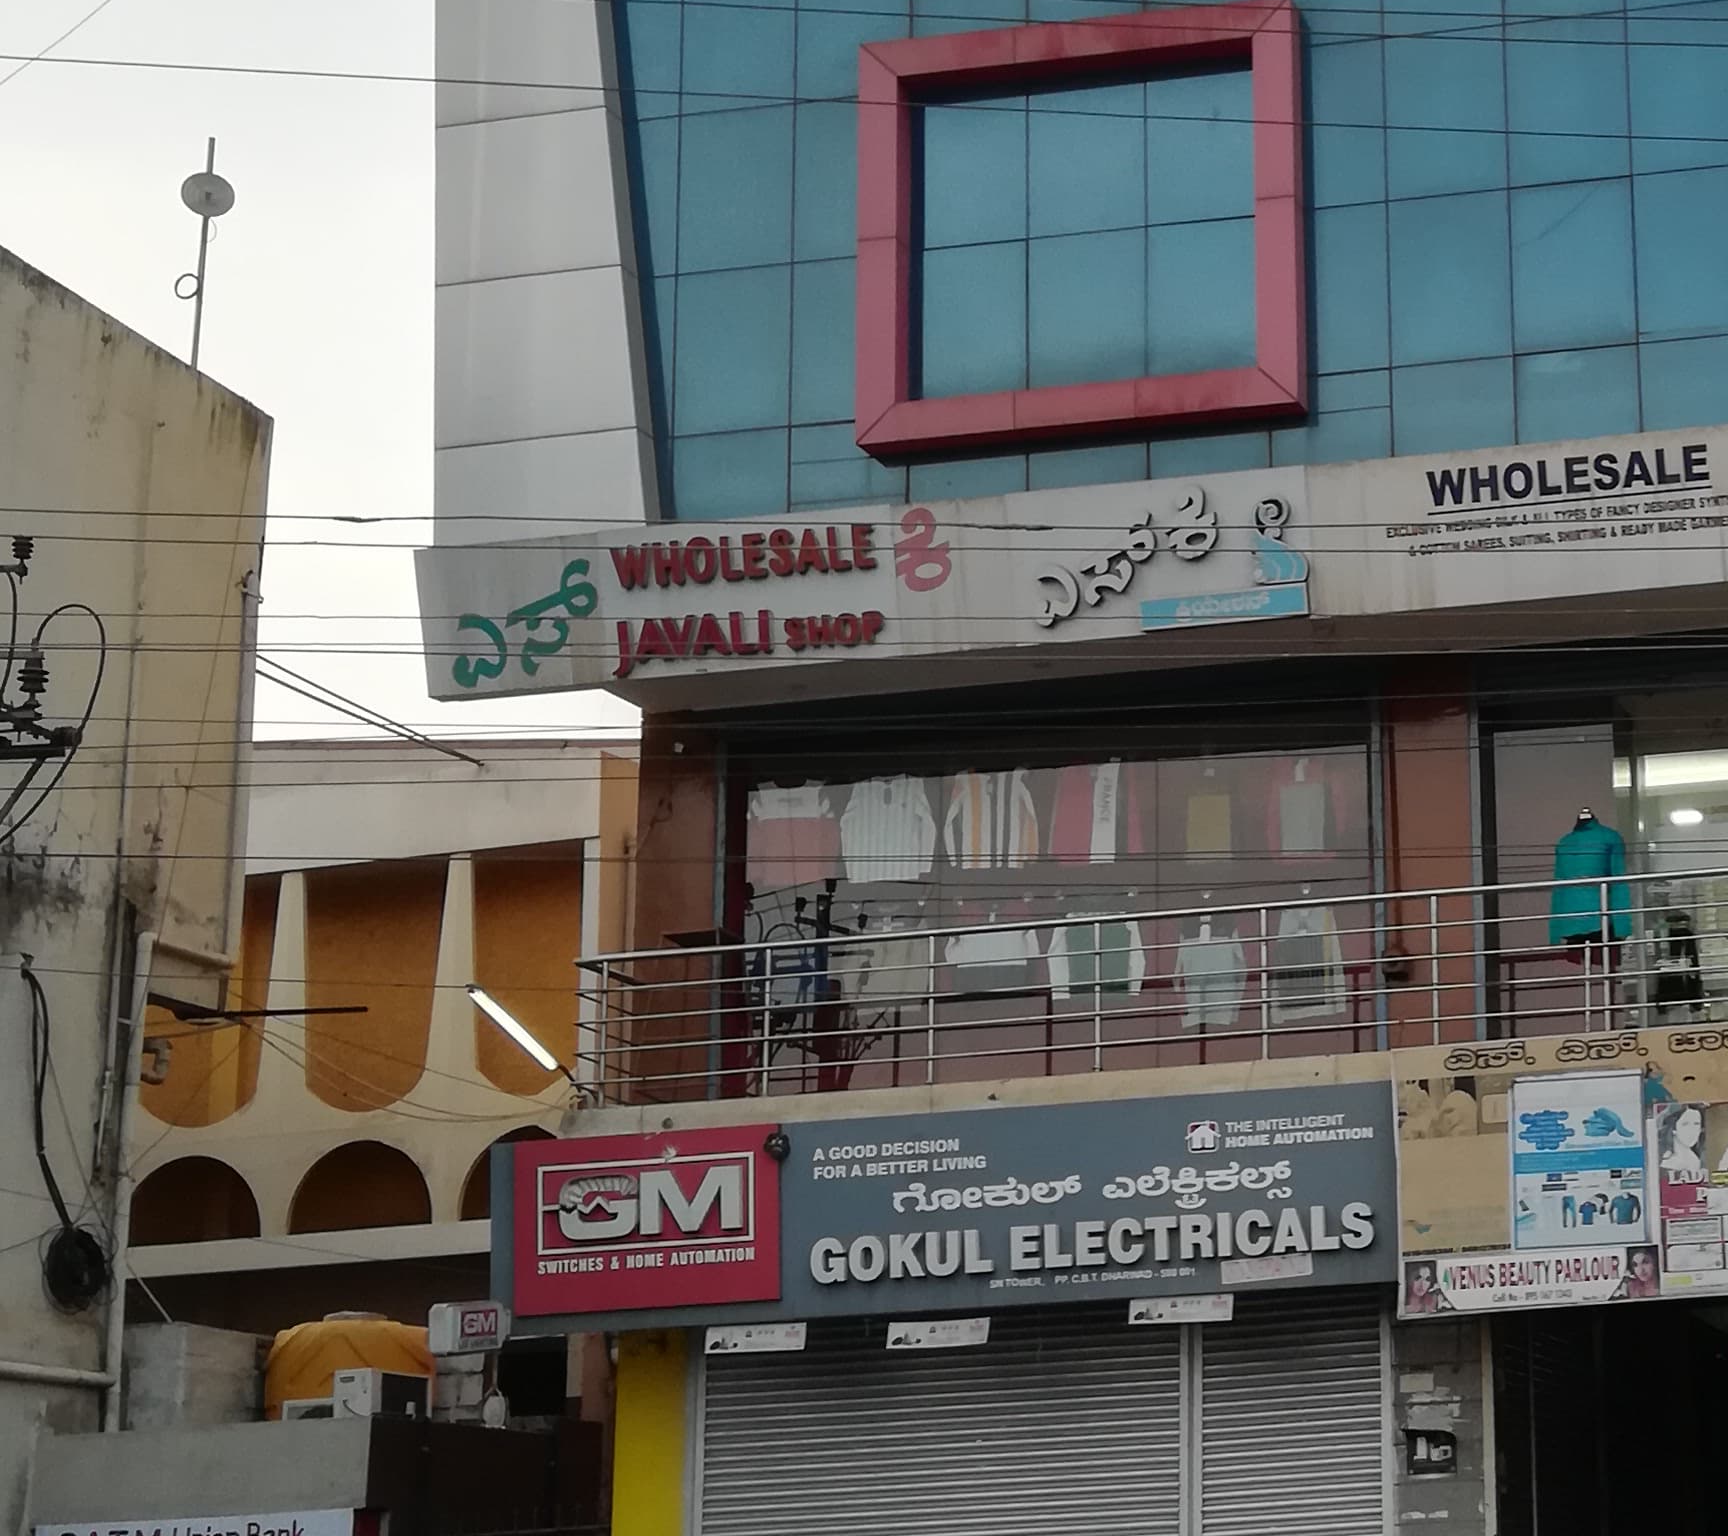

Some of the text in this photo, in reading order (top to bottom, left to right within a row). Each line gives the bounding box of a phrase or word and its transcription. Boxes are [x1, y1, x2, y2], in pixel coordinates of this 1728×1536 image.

[1426, 443, 1710, 507] WHOLESALE
[1386, 523, 1441, 539] EXCLUSIVE
[1554, 508, 1586, 522] TYPES
[1590, 506, 1602, 519] OF
[1606, 502, 1640, 517] FANCY
[1643, 498, 1696, 514] DESIGNER
[1610, 525, 1618, 539] &
[1621, 522, 1656, 537] READY
[1658, 519, 1688, 533] MADE
[610, 523, 877, 592] WHOLESALE
[612, 610, 886, 679] JAVALI SHOP
[1225, 1114, 1345, 1133] THE INTELLIGENT
[1225, 1127, 1374, 1148] HOME AUTOMATION
[813, 1139, 959, 1161] A GOOD DECISION
[813, 1156, 986, 1179] FOR A BETTER LIVING
[559, 1164, 743, 1241] GM
[893, 1175, 1082, 1213] ಗೋಕುಲ್
[810, 1202, 1375, 1286] GOKUL ELECTRICALS
[538, 1247, 755, 1275] SWITCHES & HOME AUTOMATION
[1499, 1259, 1551, 1287] BEAUTY
[1555, 1256, 1620, 1285] PARLOUR
[1101, 1270, 1152, 1282] DHARWAD
[463, 1311, 496, 1334] GM
